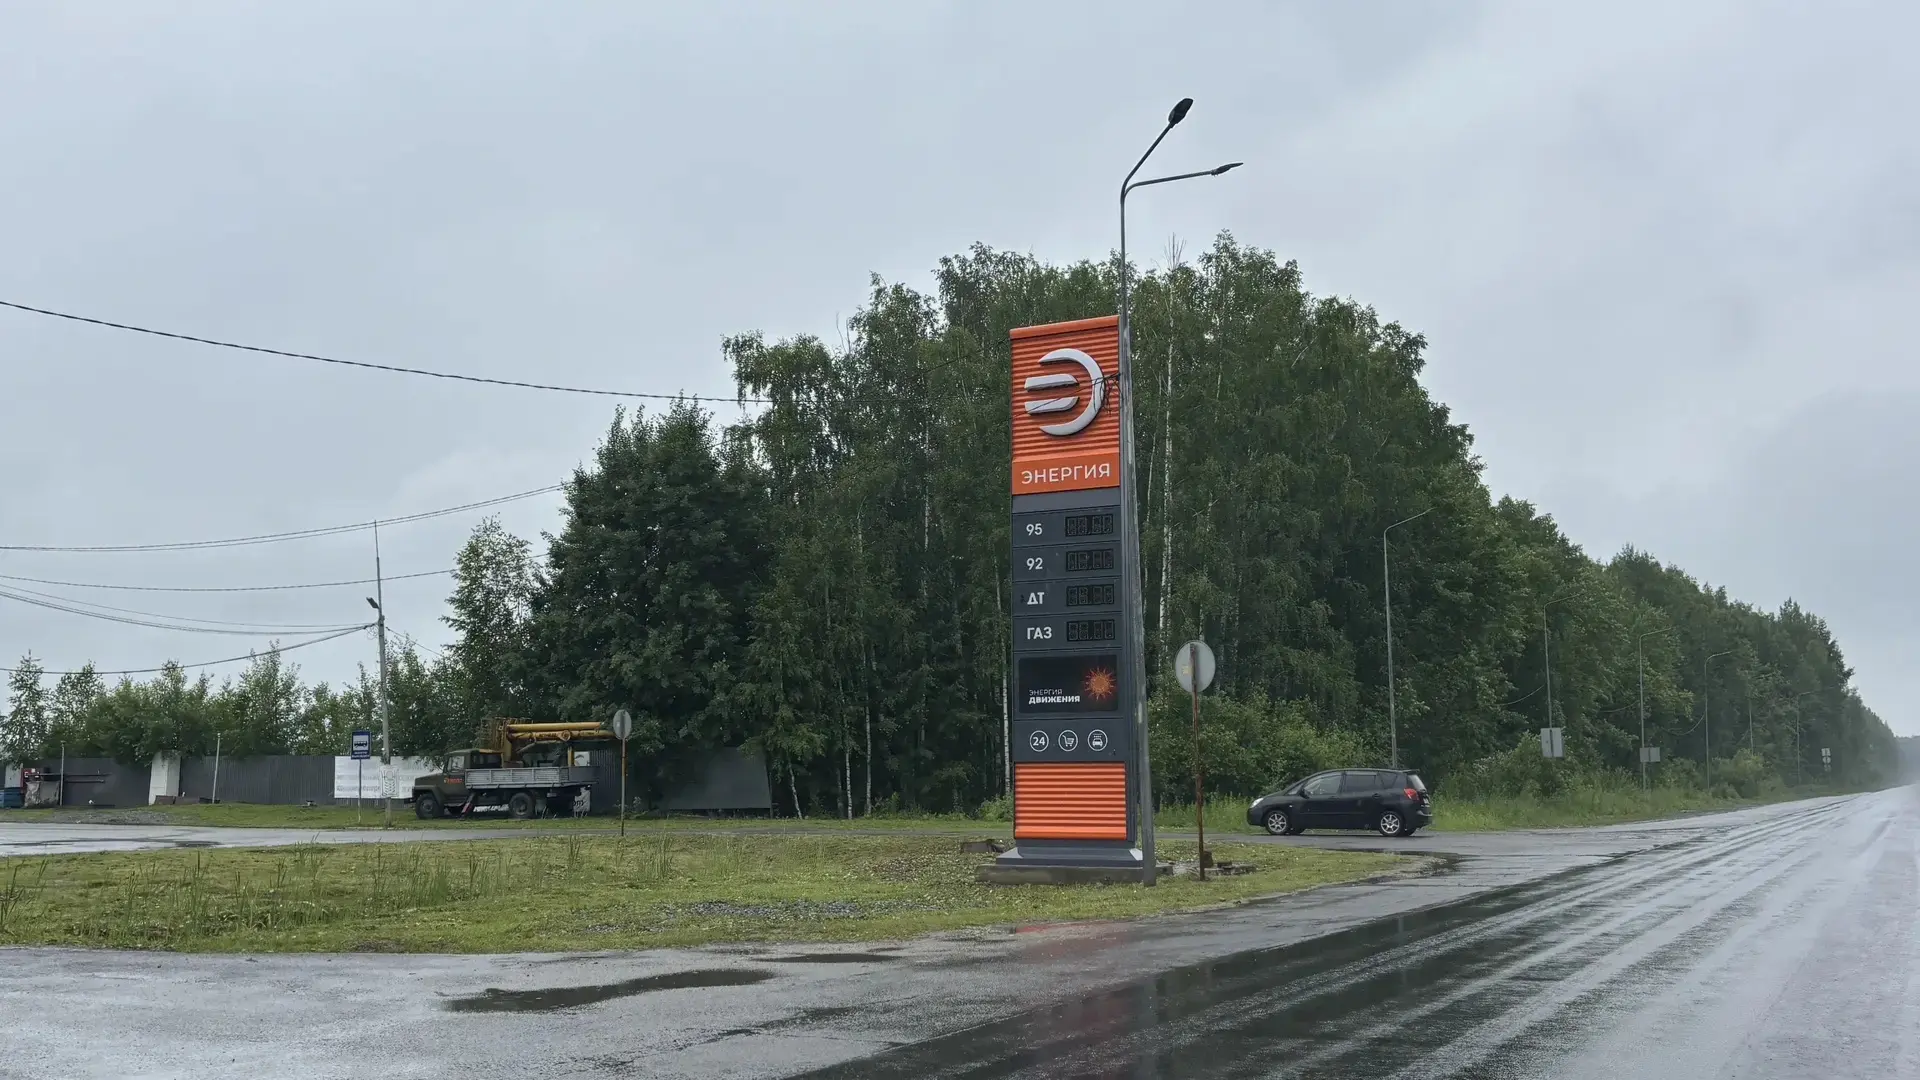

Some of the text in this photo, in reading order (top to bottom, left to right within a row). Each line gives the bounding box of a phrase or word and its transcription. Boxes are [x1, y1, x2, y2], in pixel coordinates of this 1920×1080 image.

[1021, 462, 1111, 485] ЭНЕРГИЯ
[1026, 523, 1043, 536] 95
[1026, 557, 1043, 570] 92
[1026, 592, 1045, 605] ДТ
[1026, 626, 1052, 640] ГАЗ
[1028, 688, 1063, 696] ЭНЕРГИЯ
[1028, 695, 1081, 705] ДВИЖЕНИЯ
[1032, 736, 1046, 746] 24
